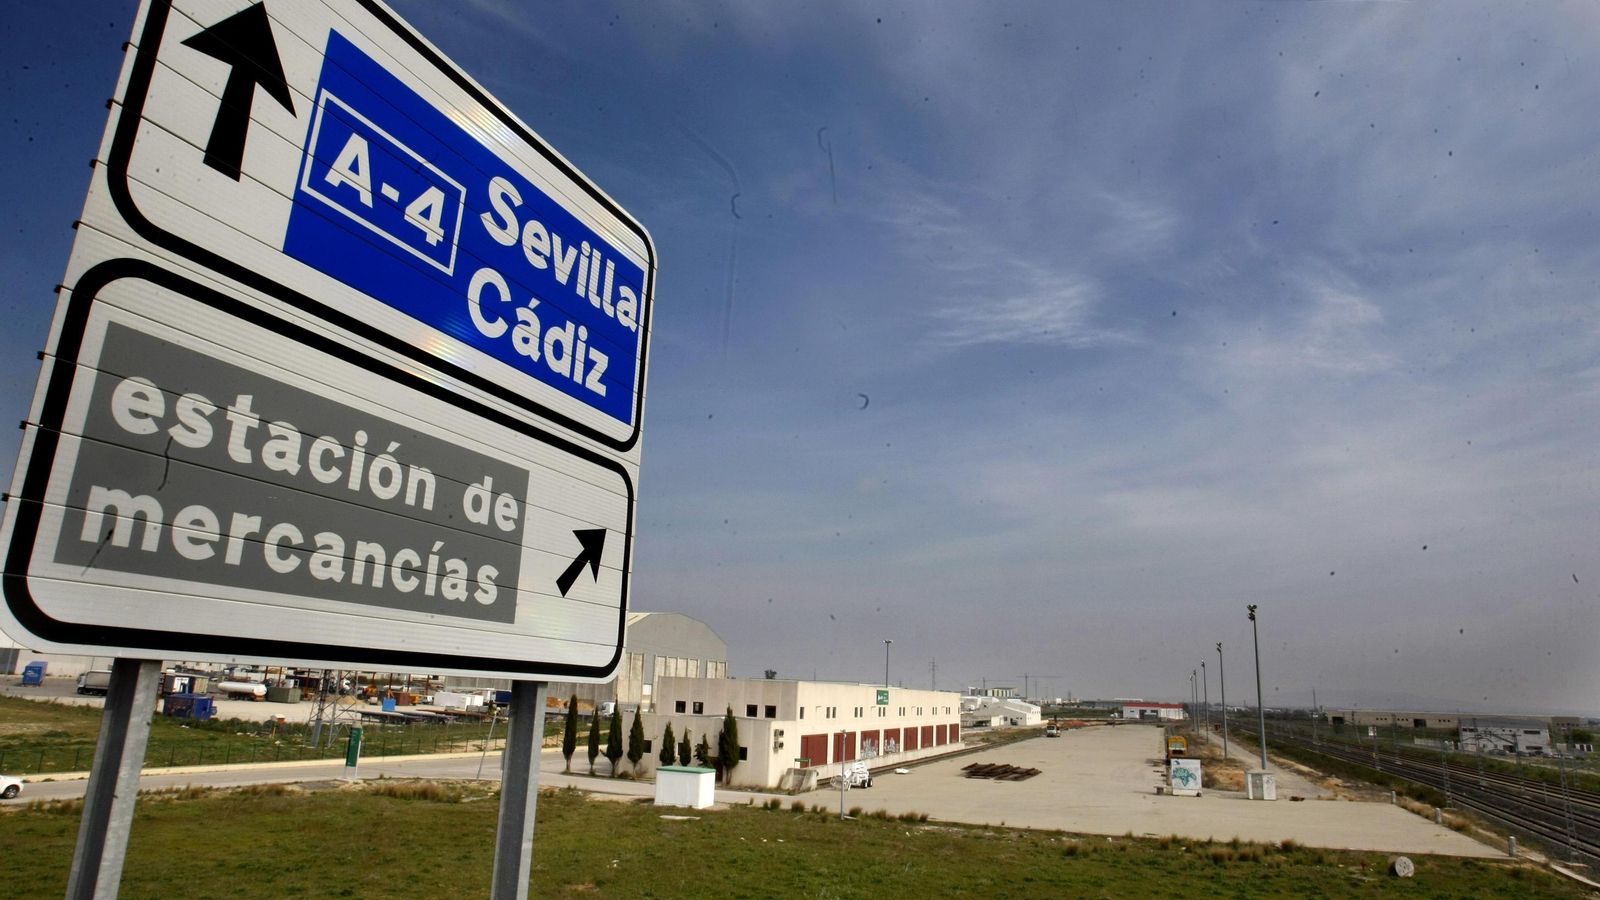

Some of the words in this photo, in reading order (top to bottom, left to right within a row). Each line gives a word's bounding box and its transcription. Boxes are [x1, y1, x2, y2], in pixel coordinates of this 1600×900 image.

[325, 133, 446, 247] A-4
[480, 176, 638, 333] Sevilla
[466, 267, 610, 396] Cádiz
[111, 376, 436, 510] estación
[463, 475, 519, 532] de
[81, 484, 500, 605] mercancías
